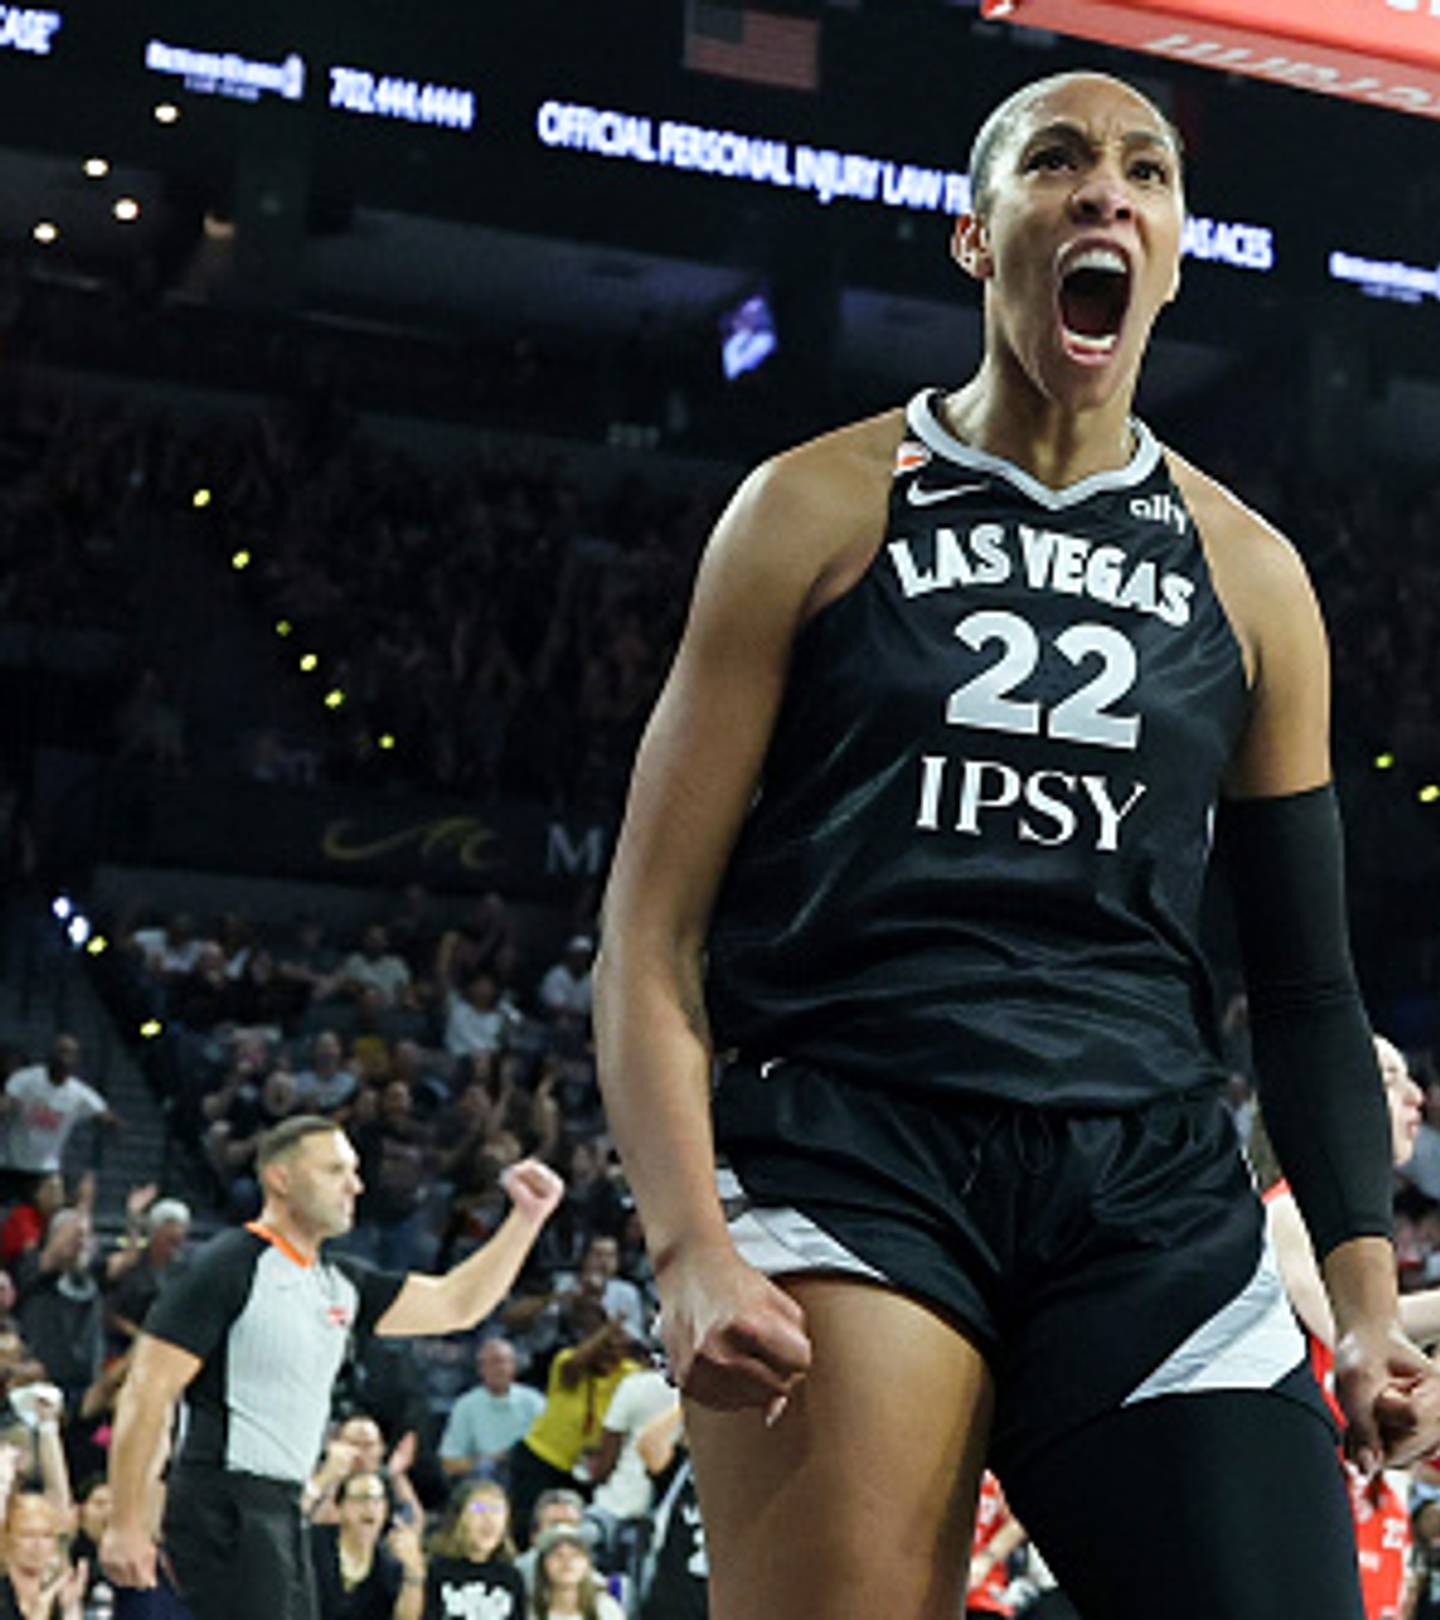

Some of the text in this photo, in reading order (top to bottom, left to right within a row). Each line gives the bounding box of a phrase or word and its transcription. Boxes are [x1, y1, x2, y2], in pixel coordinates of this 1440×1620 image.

[537, 101, 658, 162] OFFICIAL
[658, 121, 793, 187] PERSONAL
[881, 161, 944, 210] LAW
[887, 523, 1196, 628] LAS VEGAS
[945, 610, 1142, 750] 22
[915, 755, 1147, 852] IPSY
